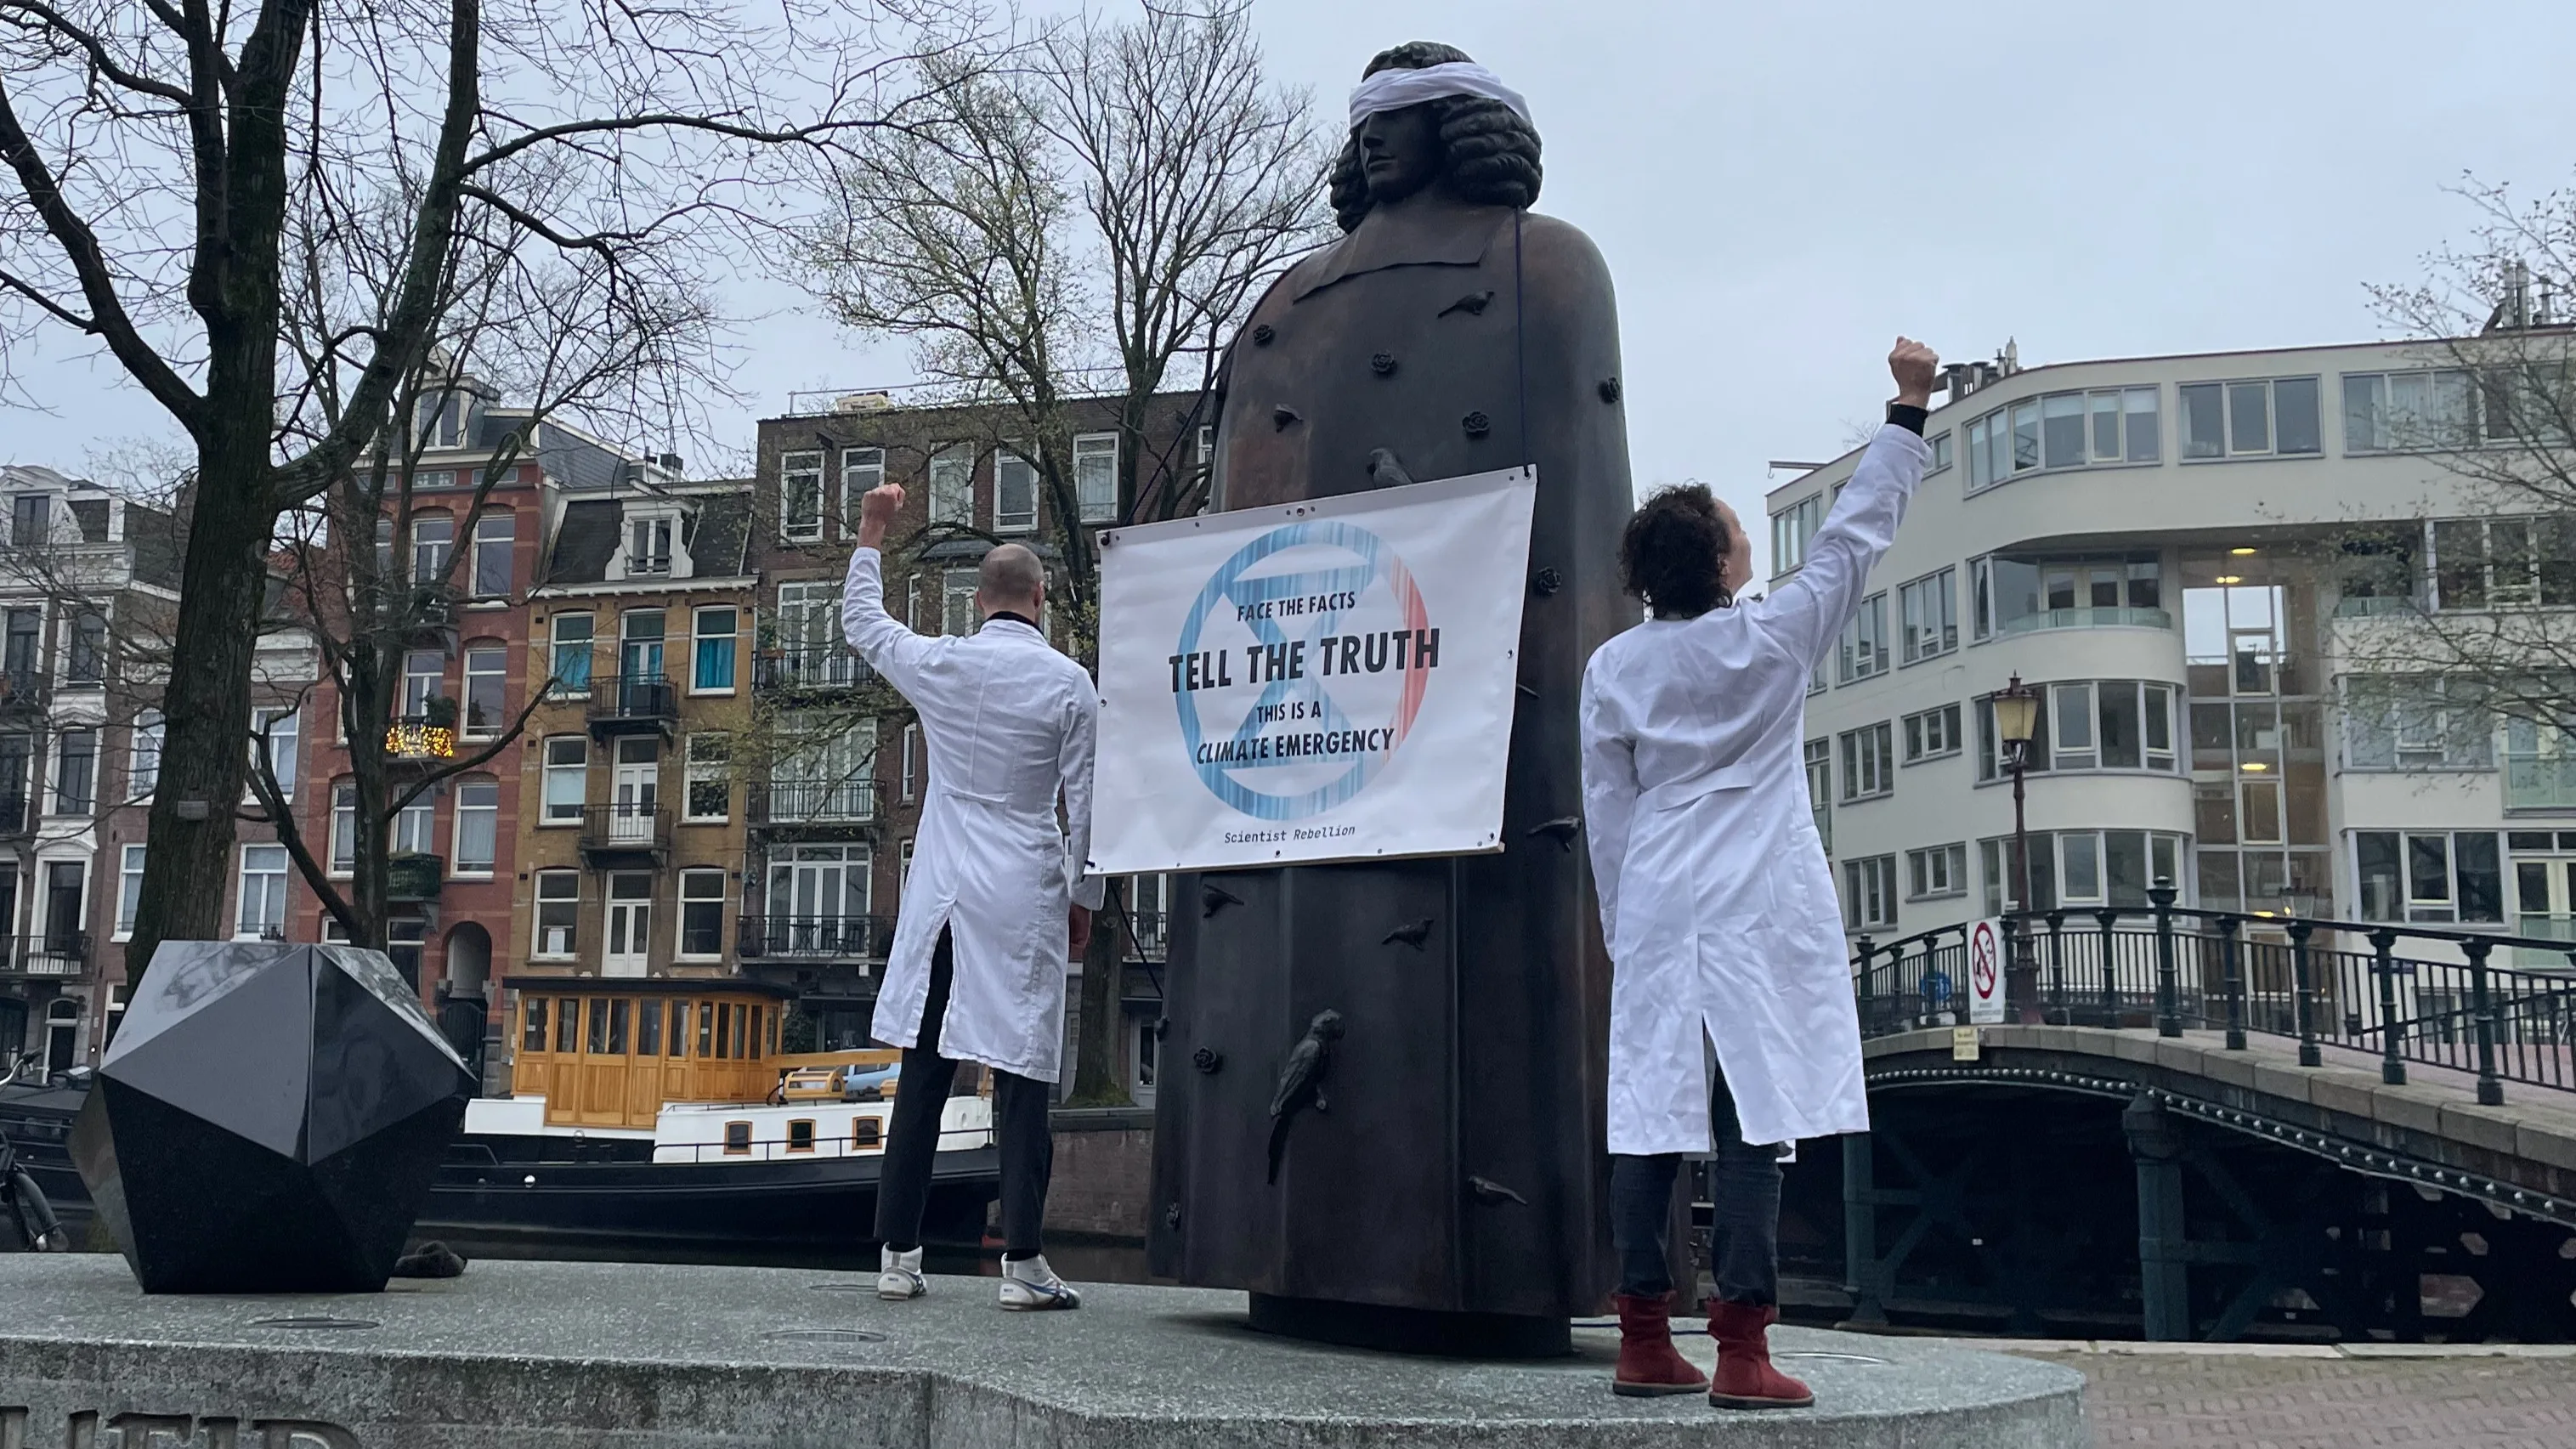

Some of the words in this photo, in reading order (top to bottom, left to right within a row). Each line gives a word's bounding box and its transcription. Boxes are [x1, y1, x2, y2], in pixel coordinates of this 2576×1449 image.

[1237, 602, 1273, 621] FACE
[1278, 597, 1304, 617] THE
[1309, 591, 1356, 614] FACTS
[1169, 649, 1231, 693] TELL
[1247, 640, 1305, 684] THE
[1320, 628, 1440, 676] TRUTH
[1256, 703, 1286, 722] THIS
[1291, 701, 1304, 719] IS
[1311, 700, 1322, 718] A
[1197, 737, 1269, 764] CLIMATE
[1276, 727, 1395, 757] EMERGENCY
[1224, 829, 1288, 844] Scientist
[1293, 824, 1356, 841] Rebellion
